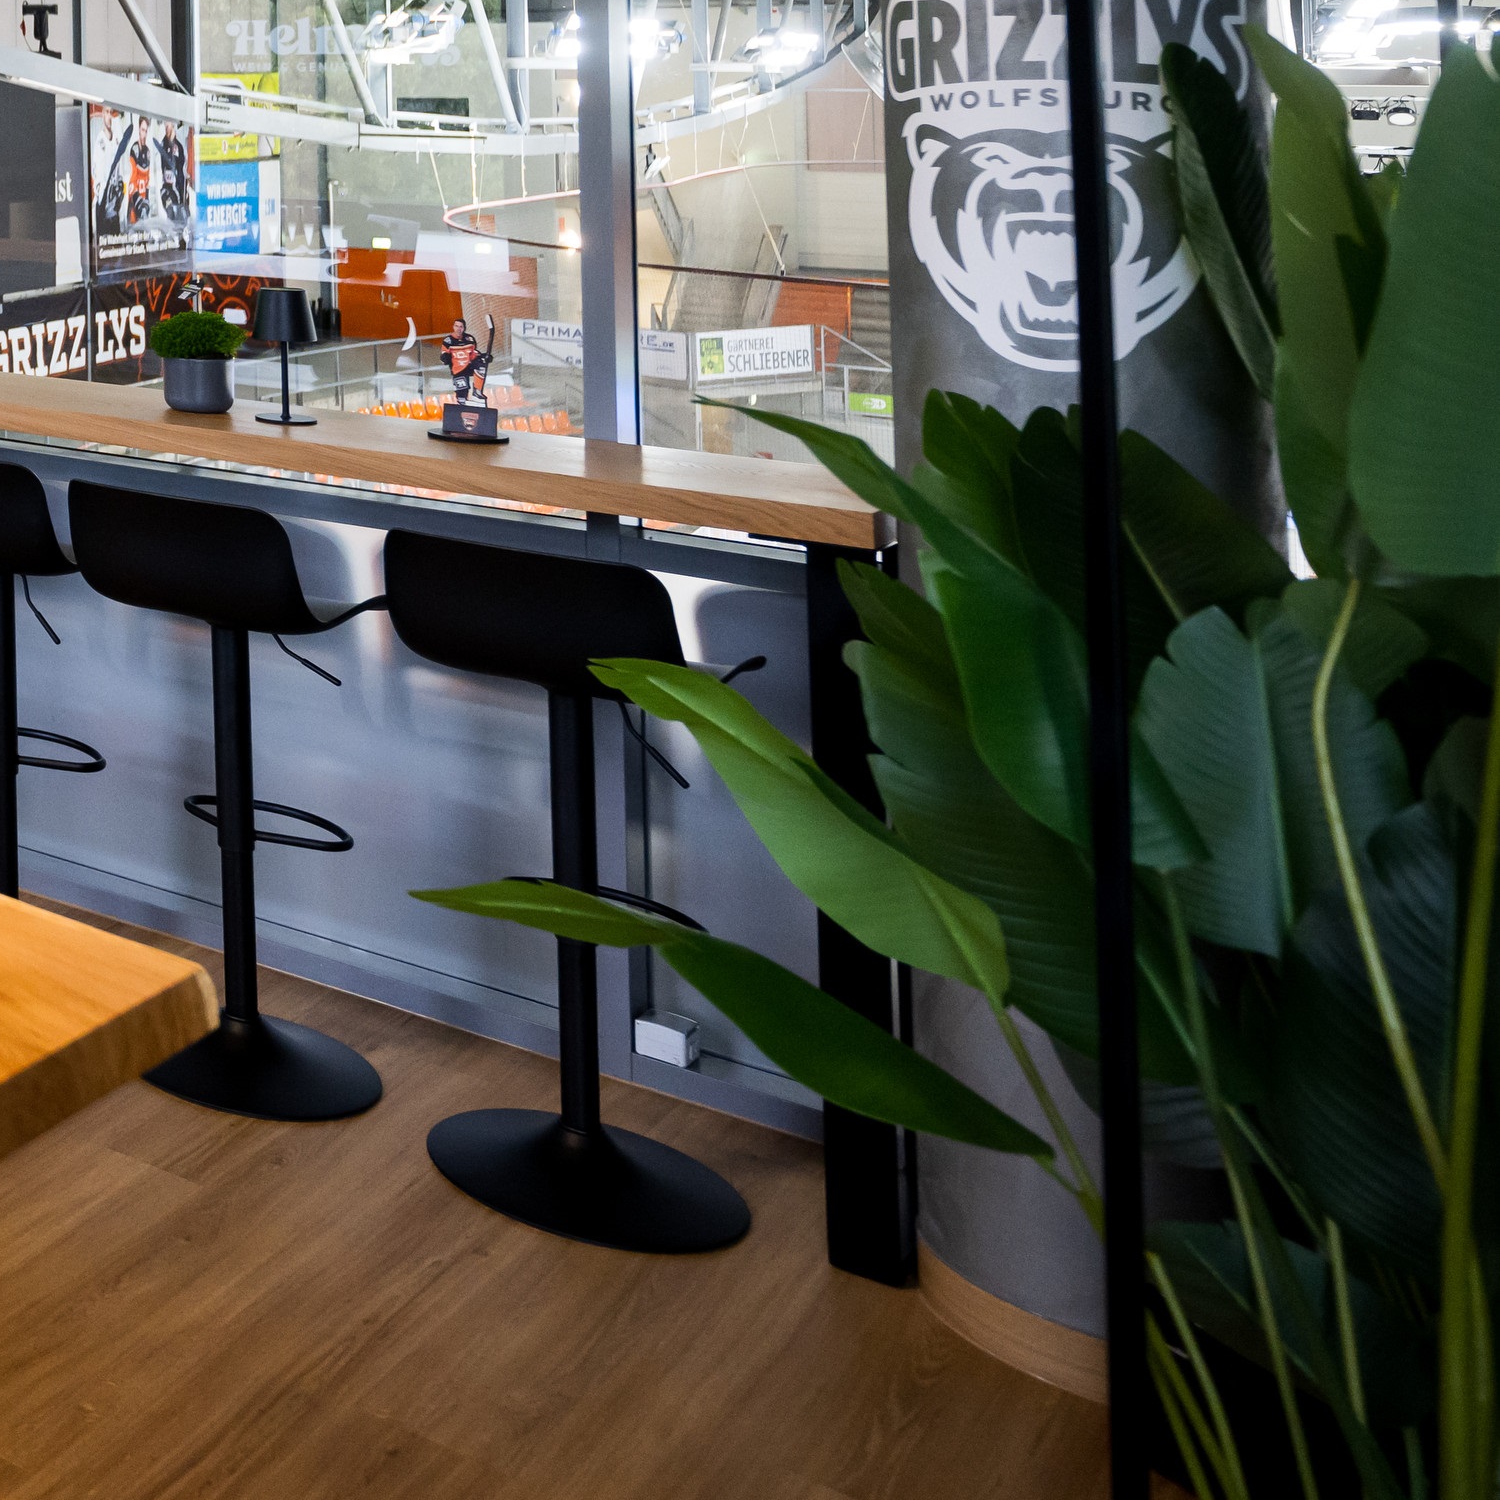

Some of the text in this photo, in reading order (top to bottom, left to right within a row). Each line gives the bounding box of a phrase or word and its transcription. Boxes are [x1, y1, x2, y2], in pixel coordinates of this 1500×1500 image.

[930, 87, 1174, 114] WOLFSUR
[206, 202, 248, 228] ENERGIE
[728, 349, 810, 373] SCHLIEBENER
